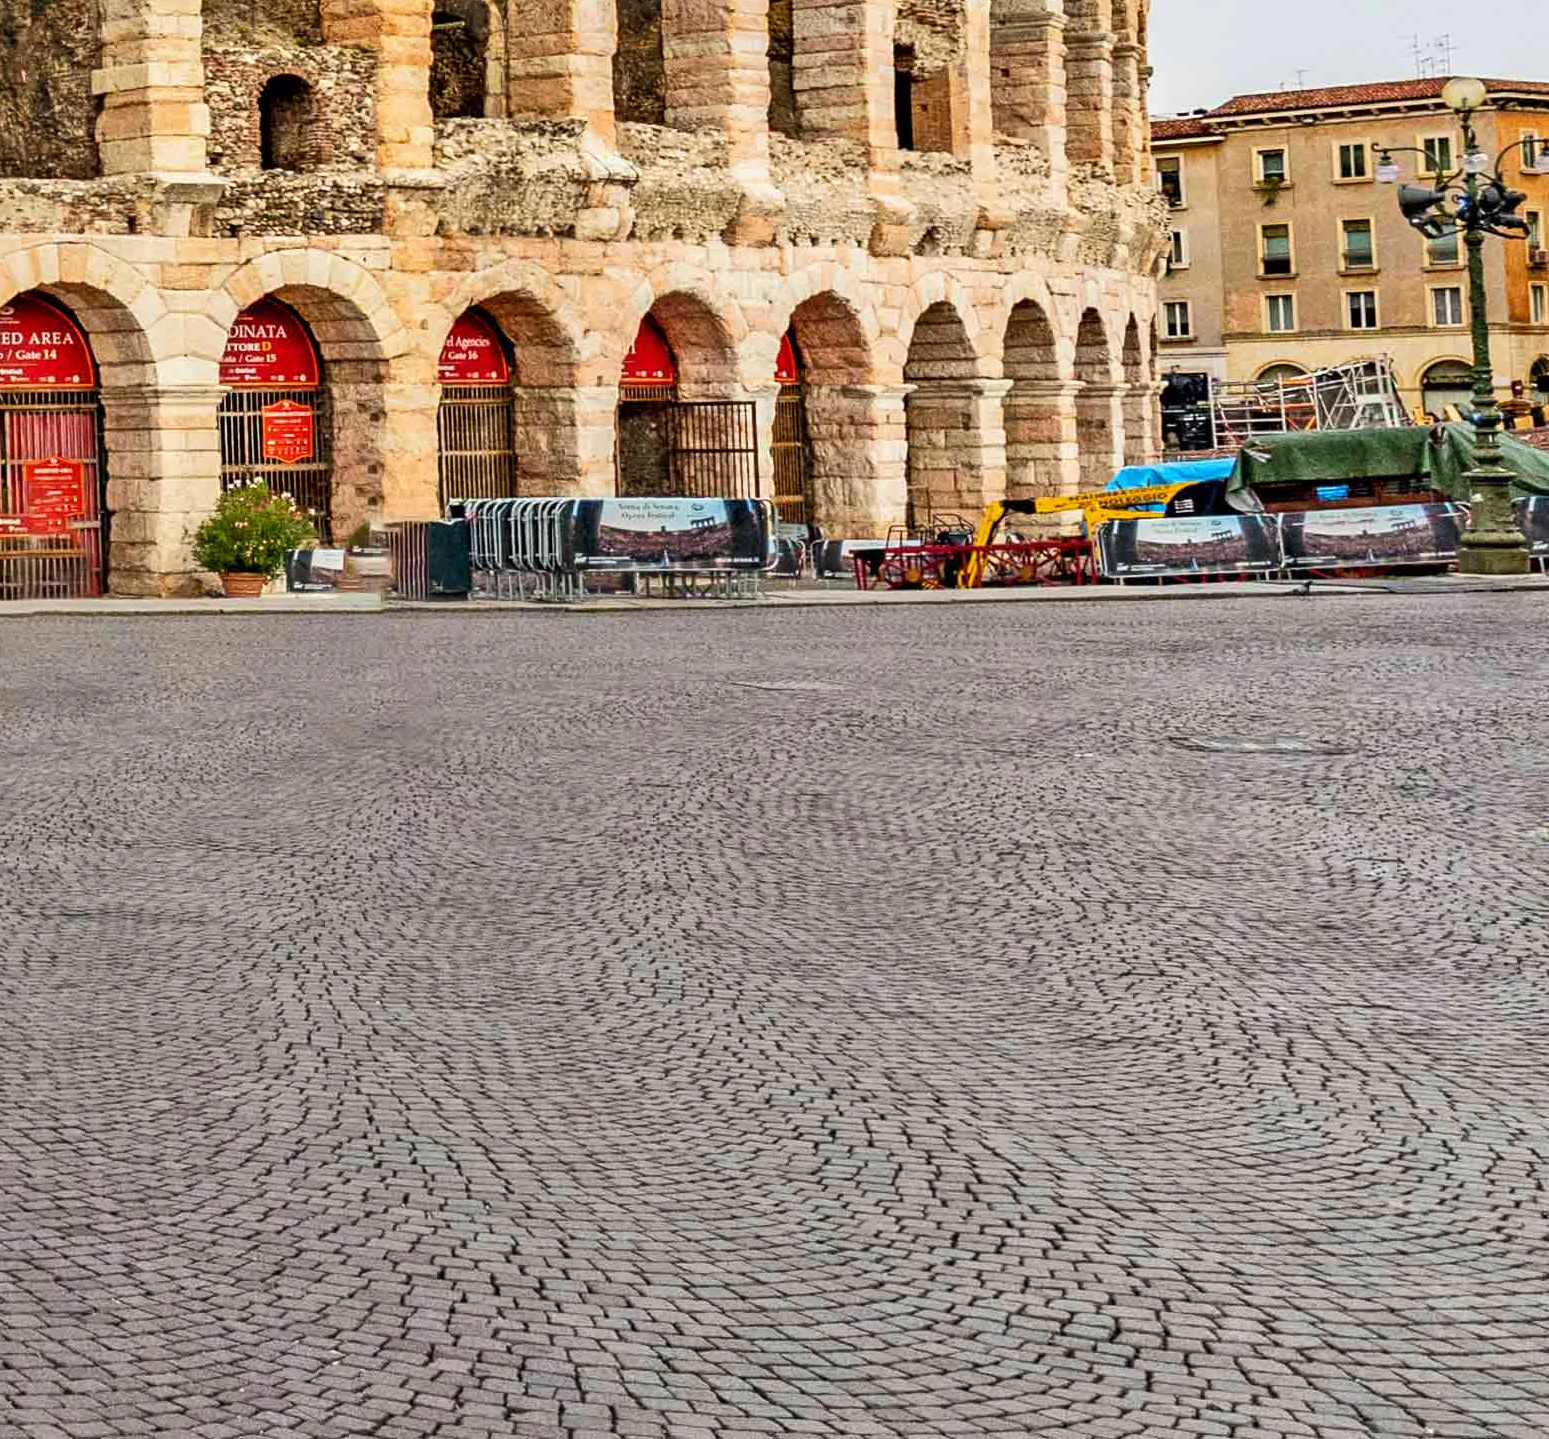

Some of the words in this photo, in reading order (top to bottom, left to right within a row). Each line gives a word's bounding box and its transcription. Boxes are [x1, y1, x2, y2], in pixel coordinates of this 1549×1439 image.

[228, 325, 287, 338] DINATA
[29, 332, 74, 345] AREA
[455, 336, 490, 351] Agencies
[262, 341, 272, 351] D
[15, 350, 42, 360] Gate
[43, 349, 58, 360] 14
[245, 354, 265, 363] Gate
[266, 354, 277, 363] 15
